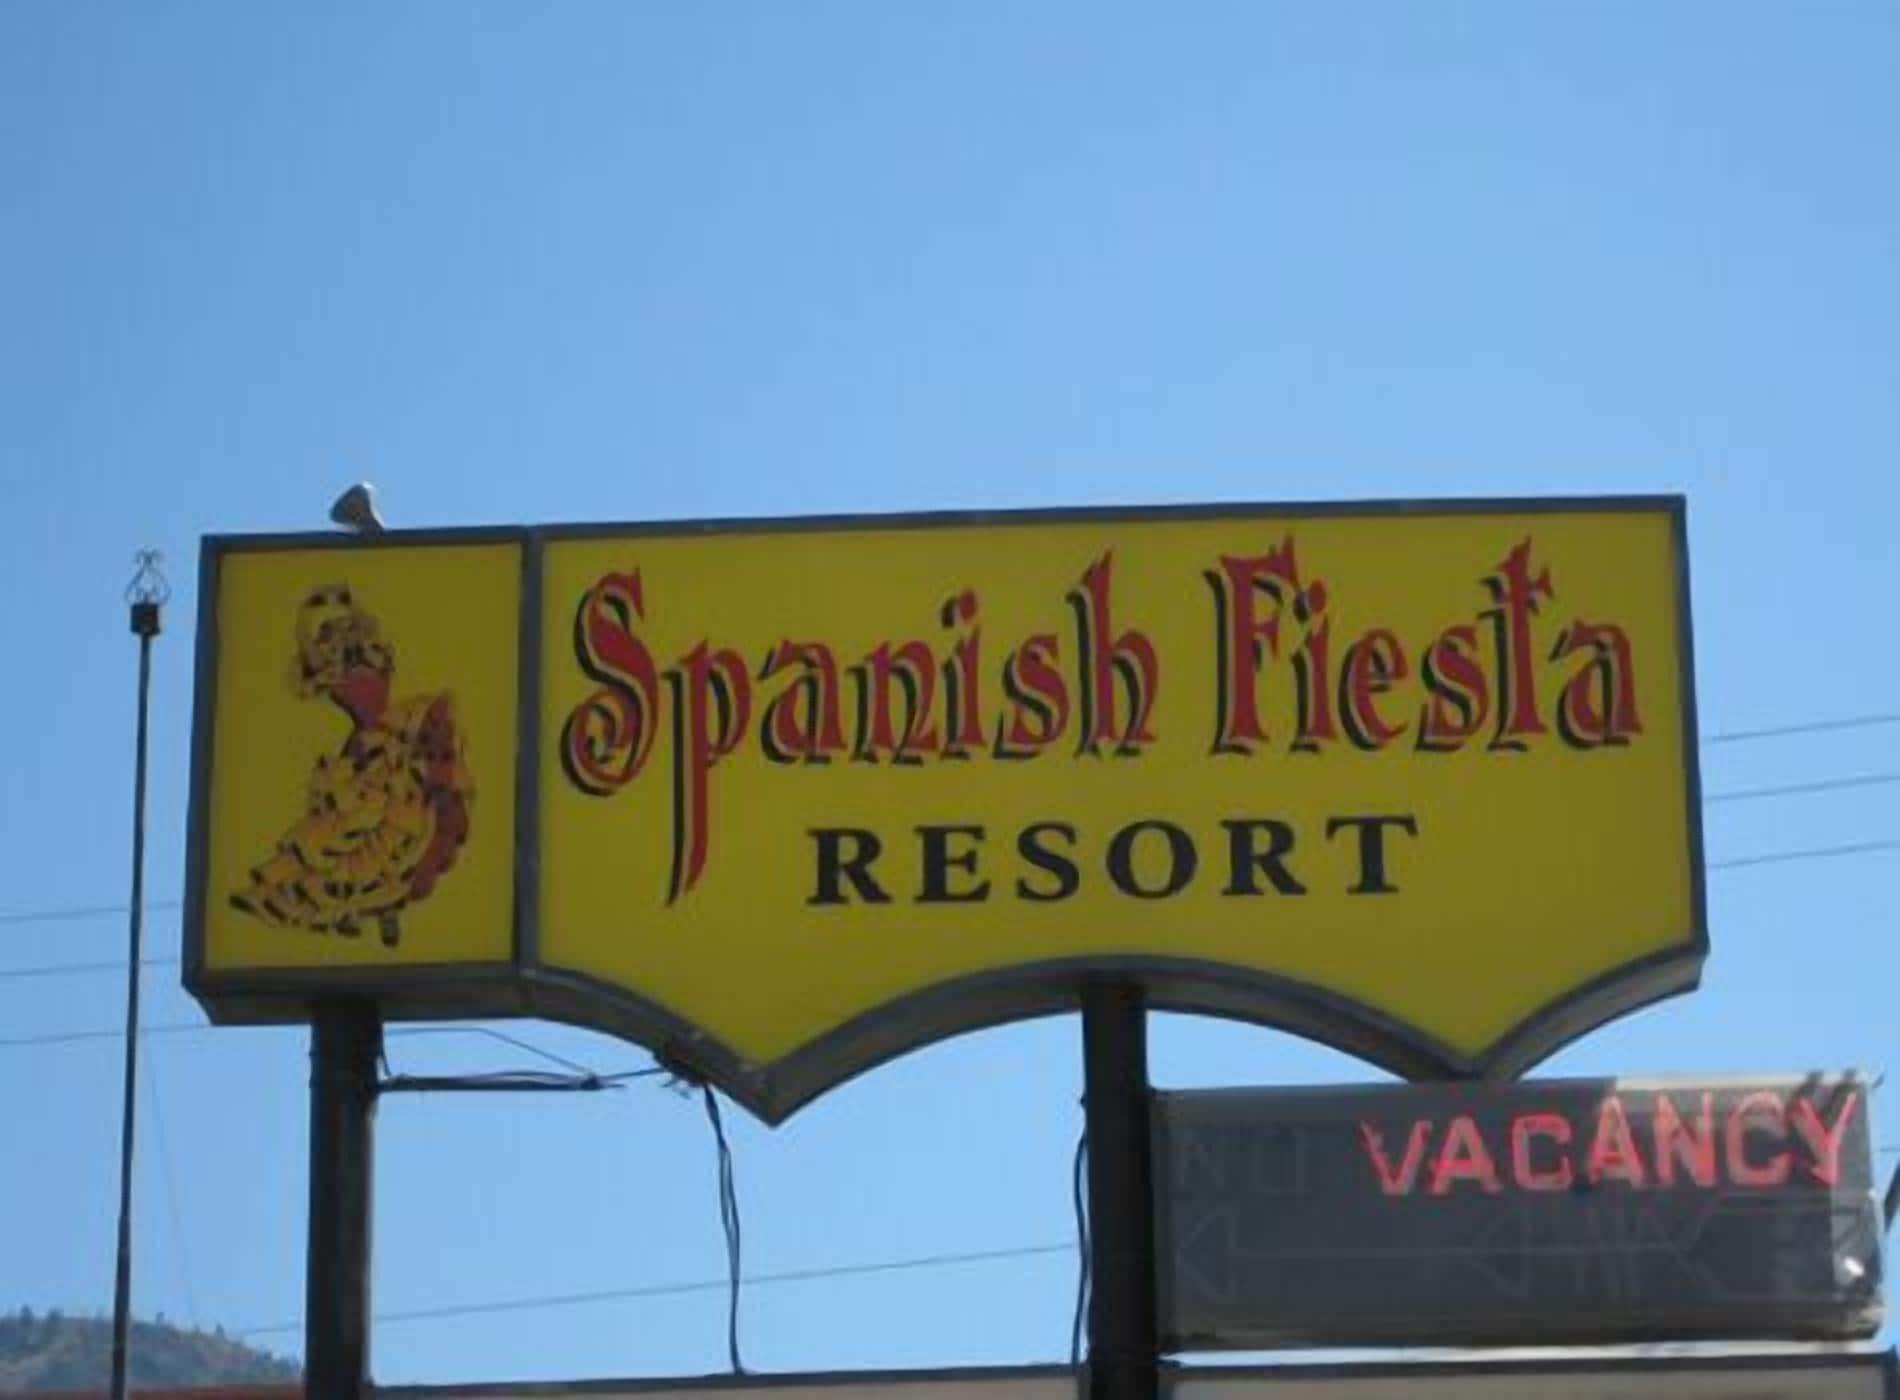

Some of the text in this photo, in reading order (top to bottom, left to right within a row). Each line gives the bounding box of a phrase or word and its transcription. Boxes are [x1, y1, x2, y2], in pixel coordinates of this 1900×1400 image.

[559, 533, 1644, 907] Spanish Fiesta
[806, 814, 1419, 906] RESORT
[1360, 1088, 1858, 1197] VACANCY
